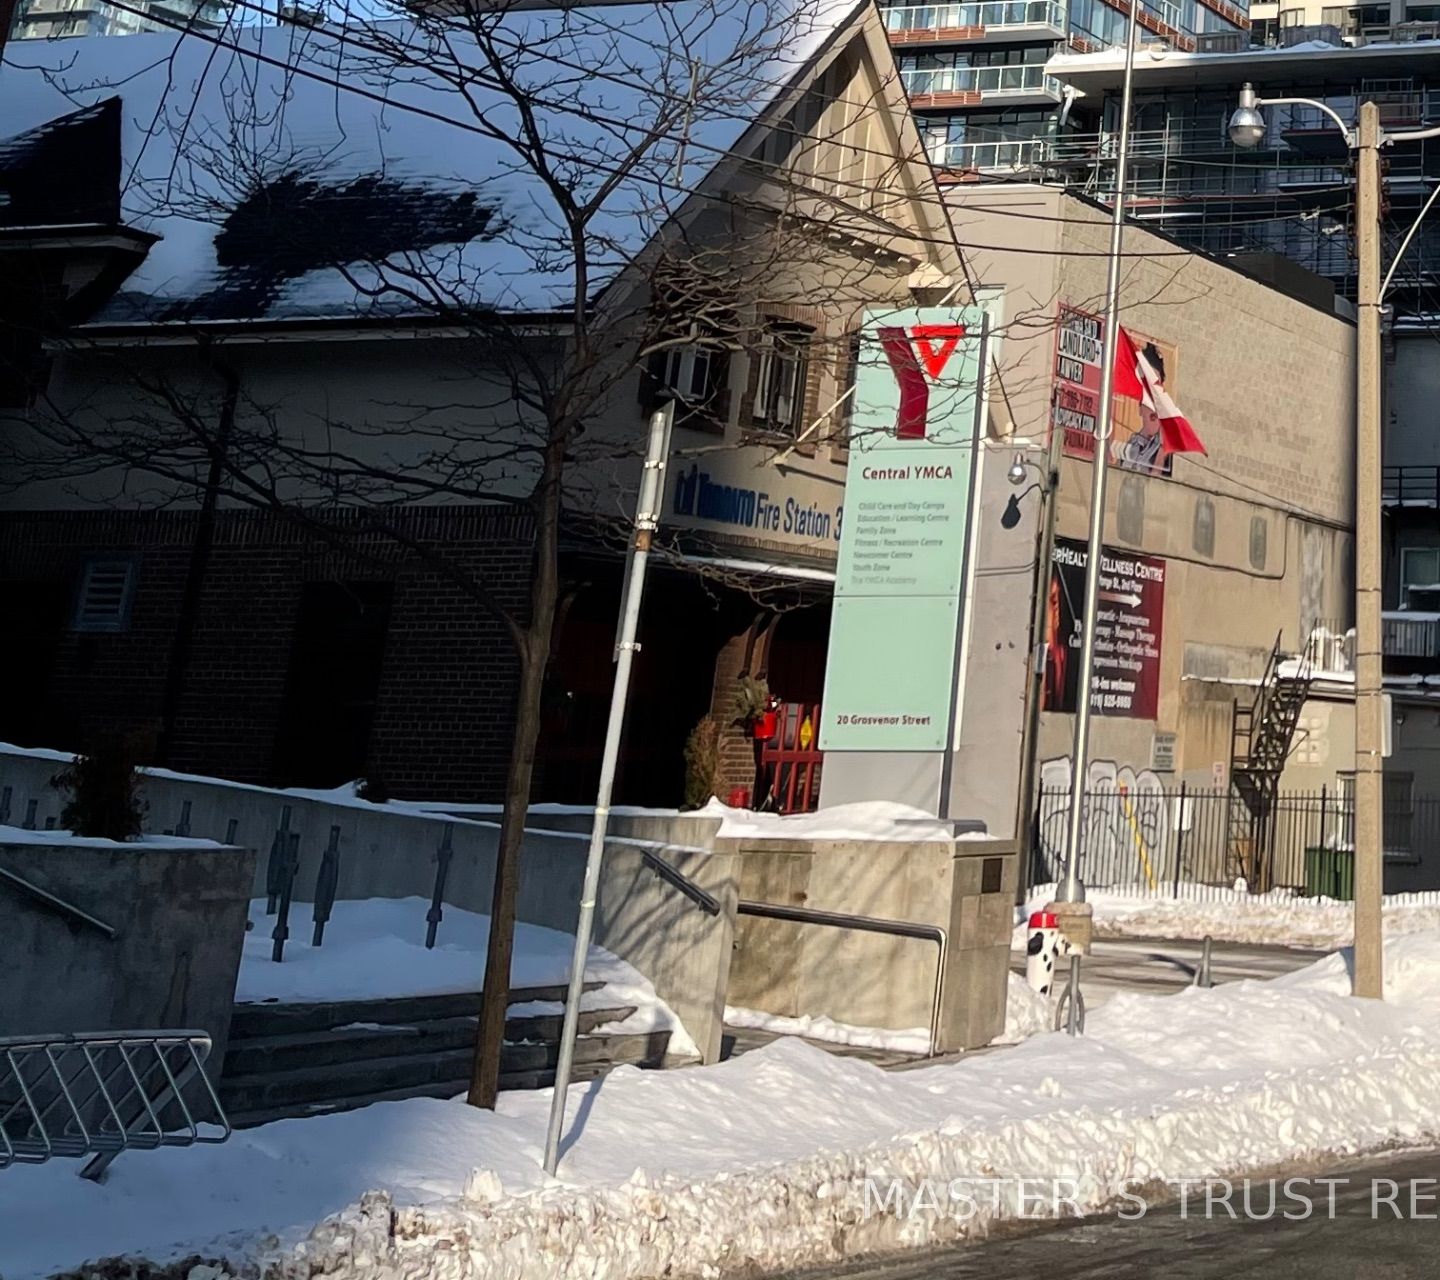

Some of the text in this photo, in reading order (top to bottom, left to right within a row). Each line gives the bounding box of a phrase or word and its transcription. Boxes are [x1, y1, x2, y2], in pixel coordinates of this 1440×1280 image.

[1057, 356, 1083, 383] LAWYER
[862, 466, 953, 480] Central YMCA
[877, 502, 892, 510] Care
[755, 492, 780, 532] Fire
[784, 497, 830, 539] Station
[833, 505, 844, 541] 3
[856, 526, 878, 535] Family
[1100, 554, 1134, 576] ELLNESS
[1135, 561, 1164, 582] CENTRE
[837, 714, 930, 725] 20 Grosvenor Street
